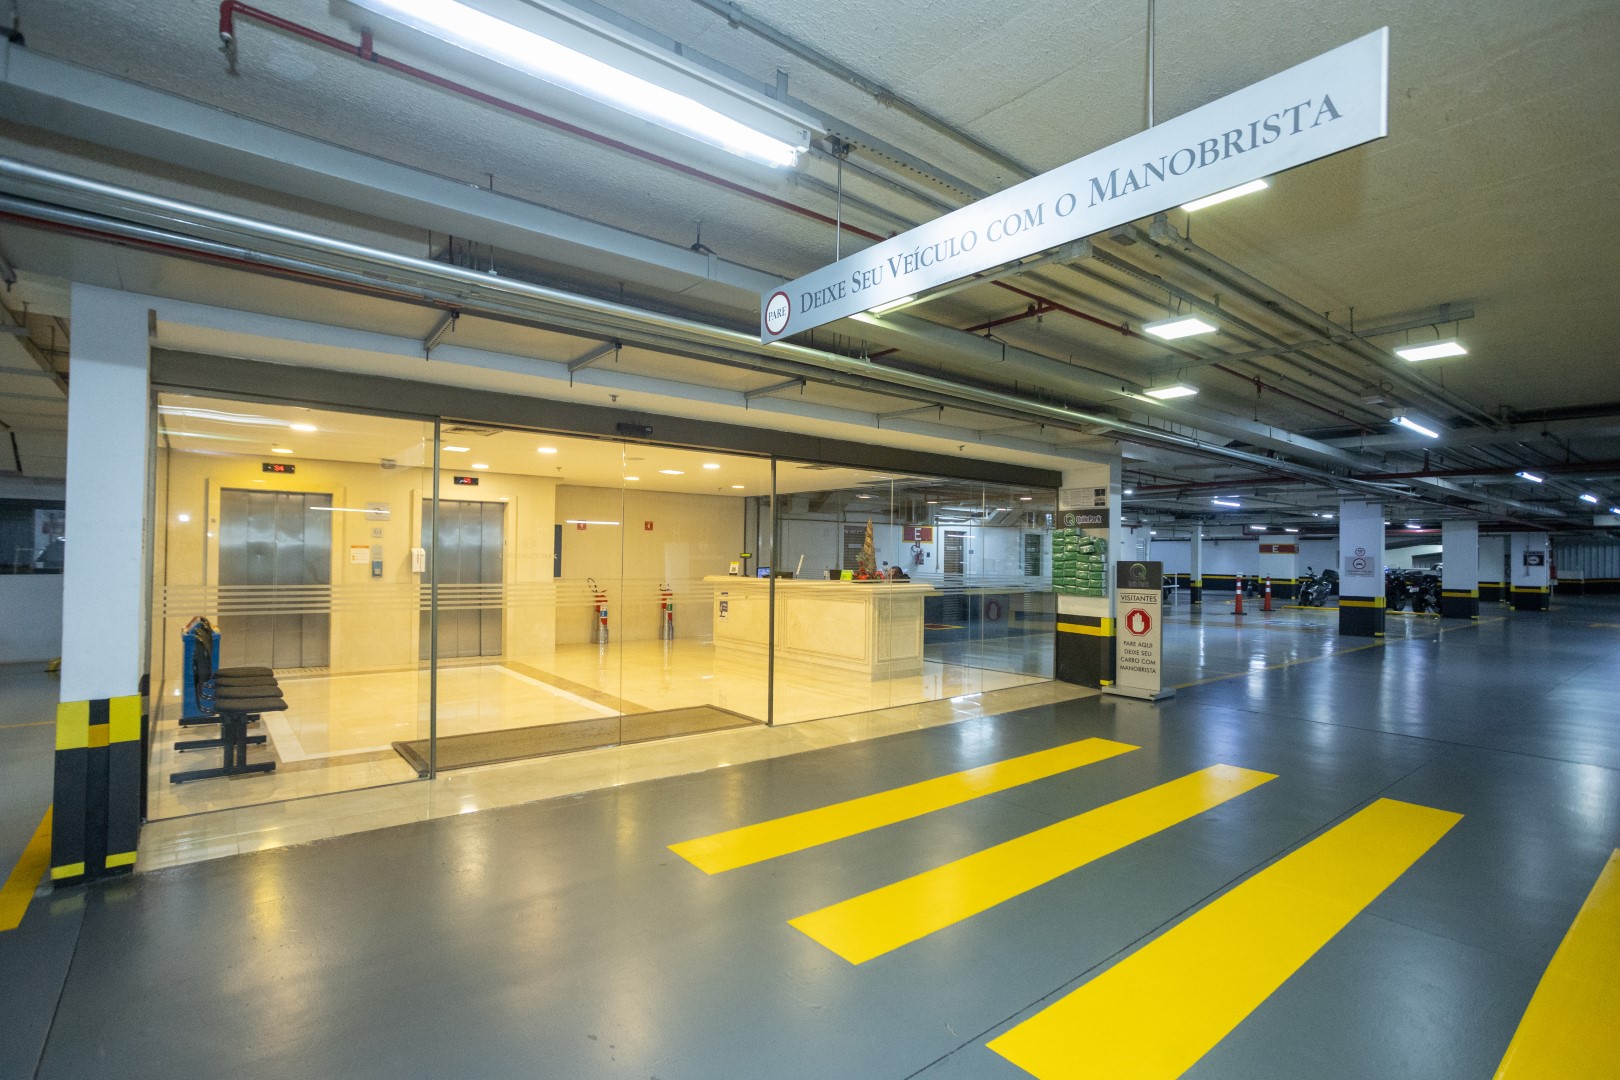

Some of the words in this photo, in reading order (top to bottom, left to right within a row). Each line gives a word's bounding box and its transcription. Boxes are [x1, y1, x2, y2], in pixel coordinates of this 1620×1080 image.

[800, 280, 846, 314] DEIXE
[851, 265, 884, 294] SEU
[887, 230, 978, 279] VEÍCULO
[986, 202, 1045, 242] COM
[1055, 193, 1077, 217] O
[1088, 93, 1343, 208] MANOBRISTA
[768, 306, 787, 321] PARE
[914, 527, 921, 541] E
[1272, 545, 1279, 553] E
[1120, 594, 1158, 603] VISITANTES
[1124, 648, 1140, 656] DEIXE
[1120, 665, 1157, 673] MANOBRISTA
